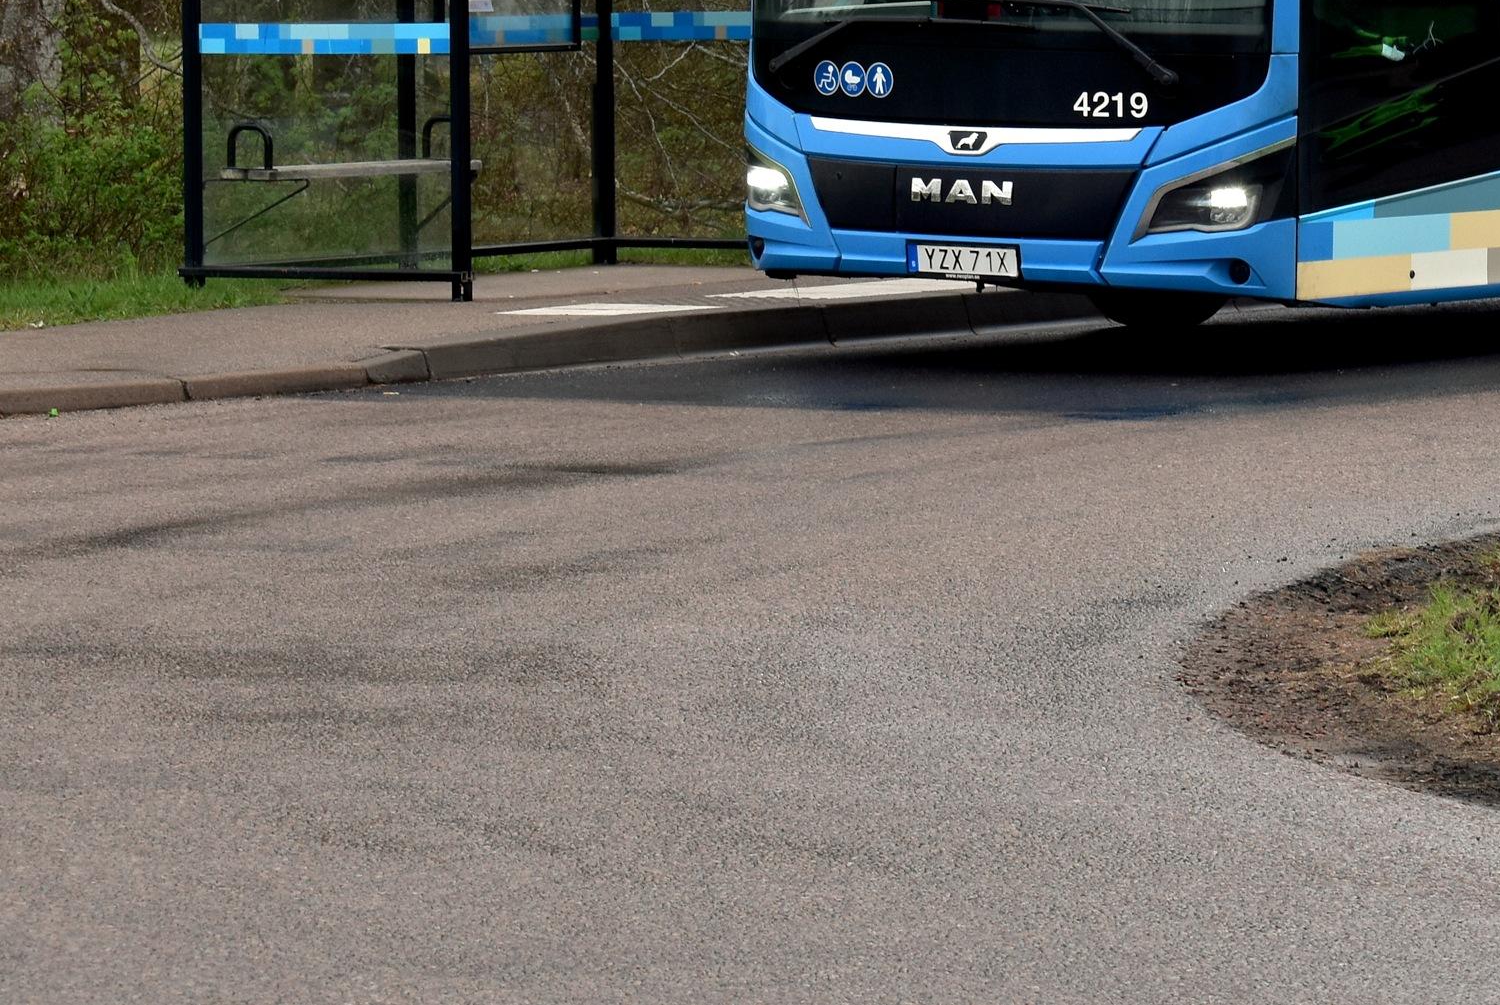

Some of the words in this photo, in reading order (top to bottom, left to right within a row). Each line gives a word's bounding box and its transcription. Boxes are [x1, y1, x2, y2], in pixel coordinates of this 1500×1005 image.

[1072, 91, 1149, 119] 4219
[910, 176, 1014, 206] MAN
[924, 247, 963, 271] YZX
[969, 250, 1009, 273] 71X
